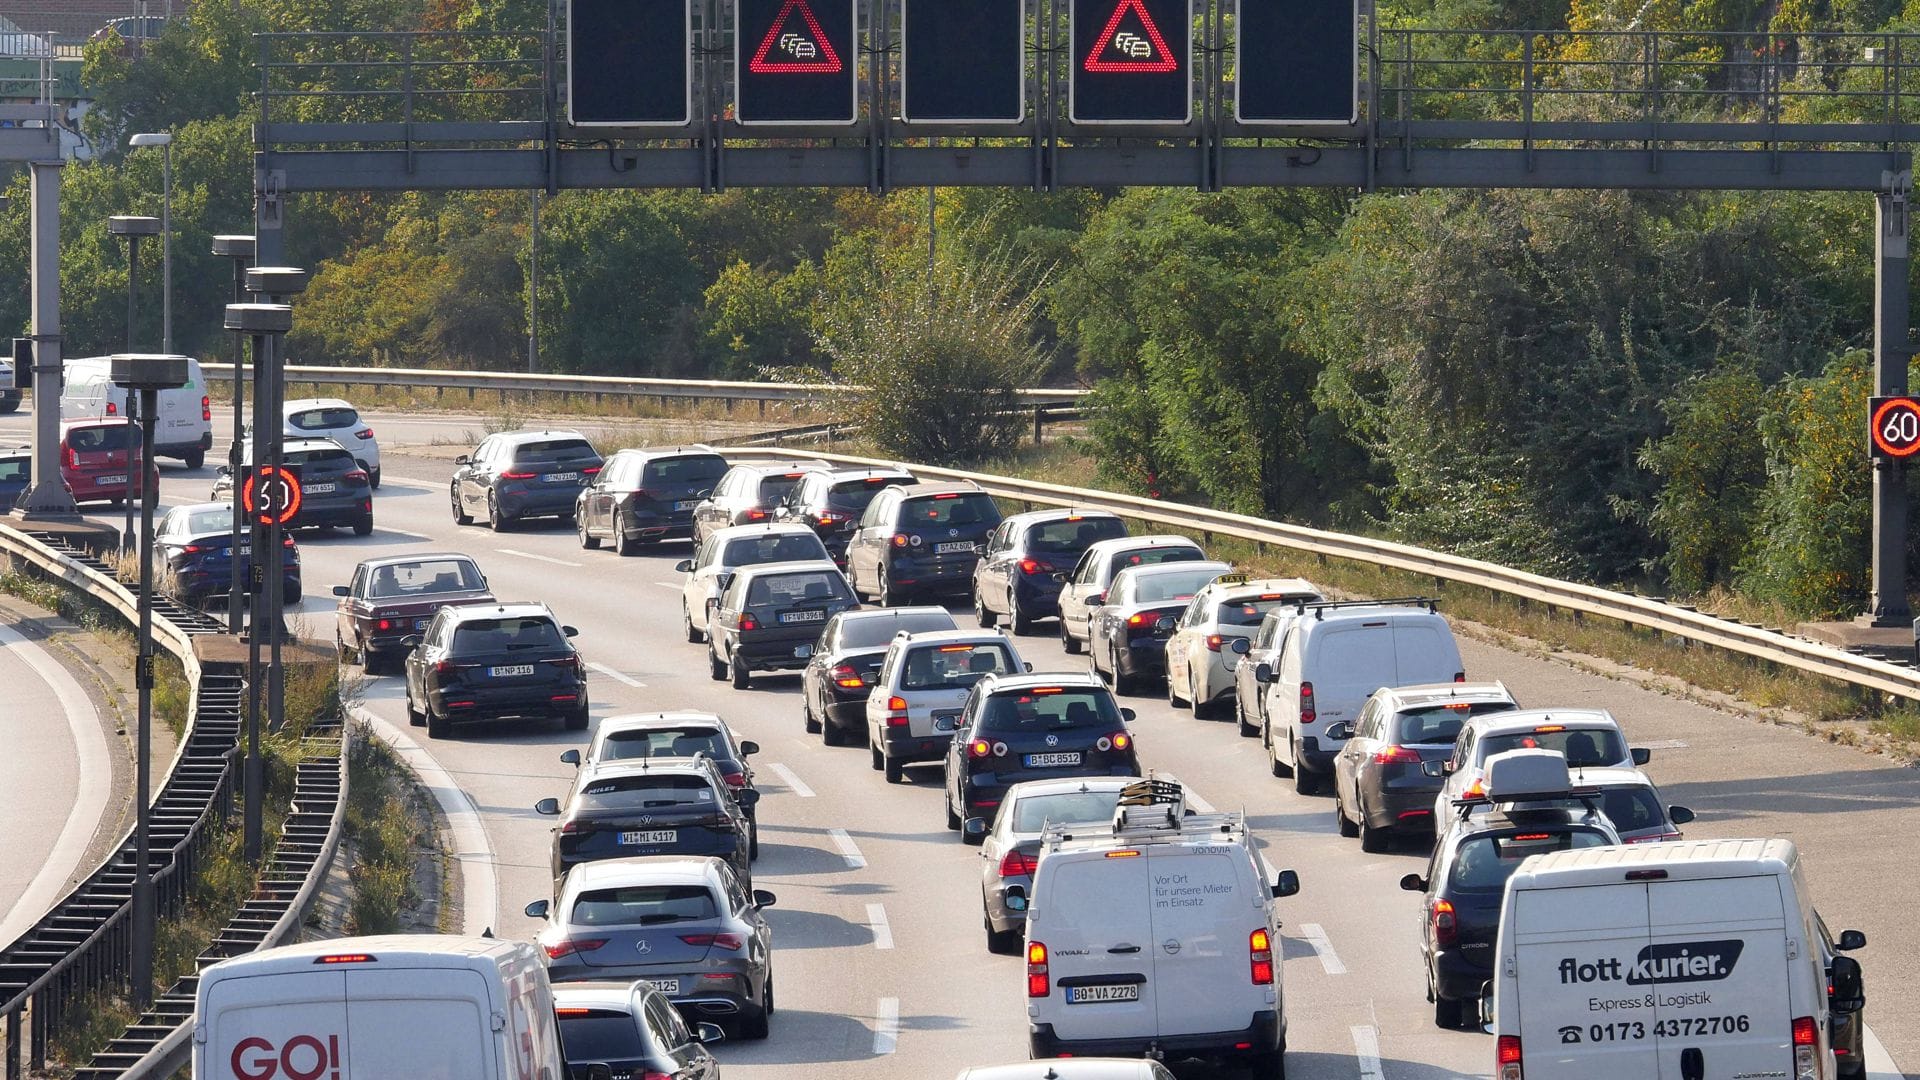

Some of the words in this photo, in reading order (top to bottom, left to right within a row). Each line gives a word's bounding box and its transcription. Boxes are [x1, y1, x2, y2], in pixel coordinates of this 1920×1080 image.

[1883, 412, 1917, 442] 60
[1043, 754, 1056, 764] BC
[1057, 753, 1079, 763] 8512
[623, 833, 633, 843] WI
[652, 831, 674, 842] 4117
[1154, 875, 1170, 885] Vor
[1172, 873, 1188, 884] Ort
[1155, 886, 1168, 897] für
[1170, 887, 1201, 896] unsere
[1203, 884, 1232, 895] Mieter
[1156, 898, 1169, 908] im
[1171, 896, 1204, 908] Einsatz
[1558, 957, 1622, 984] flott
[1095, 986, 1109, 999] VA
[1110, 985, 1137, 999] 2278
[1588, 995, 1641, 1013] Express
[1644, 994, 1655, 1008] &
[1659, 991, 1712, 1010] Logistik
[1589, 1021, 1646, 1043] 0173
[1652, 1014, 1750, 1038] 4372706
[231, 1034, 340, 1080] GO!
